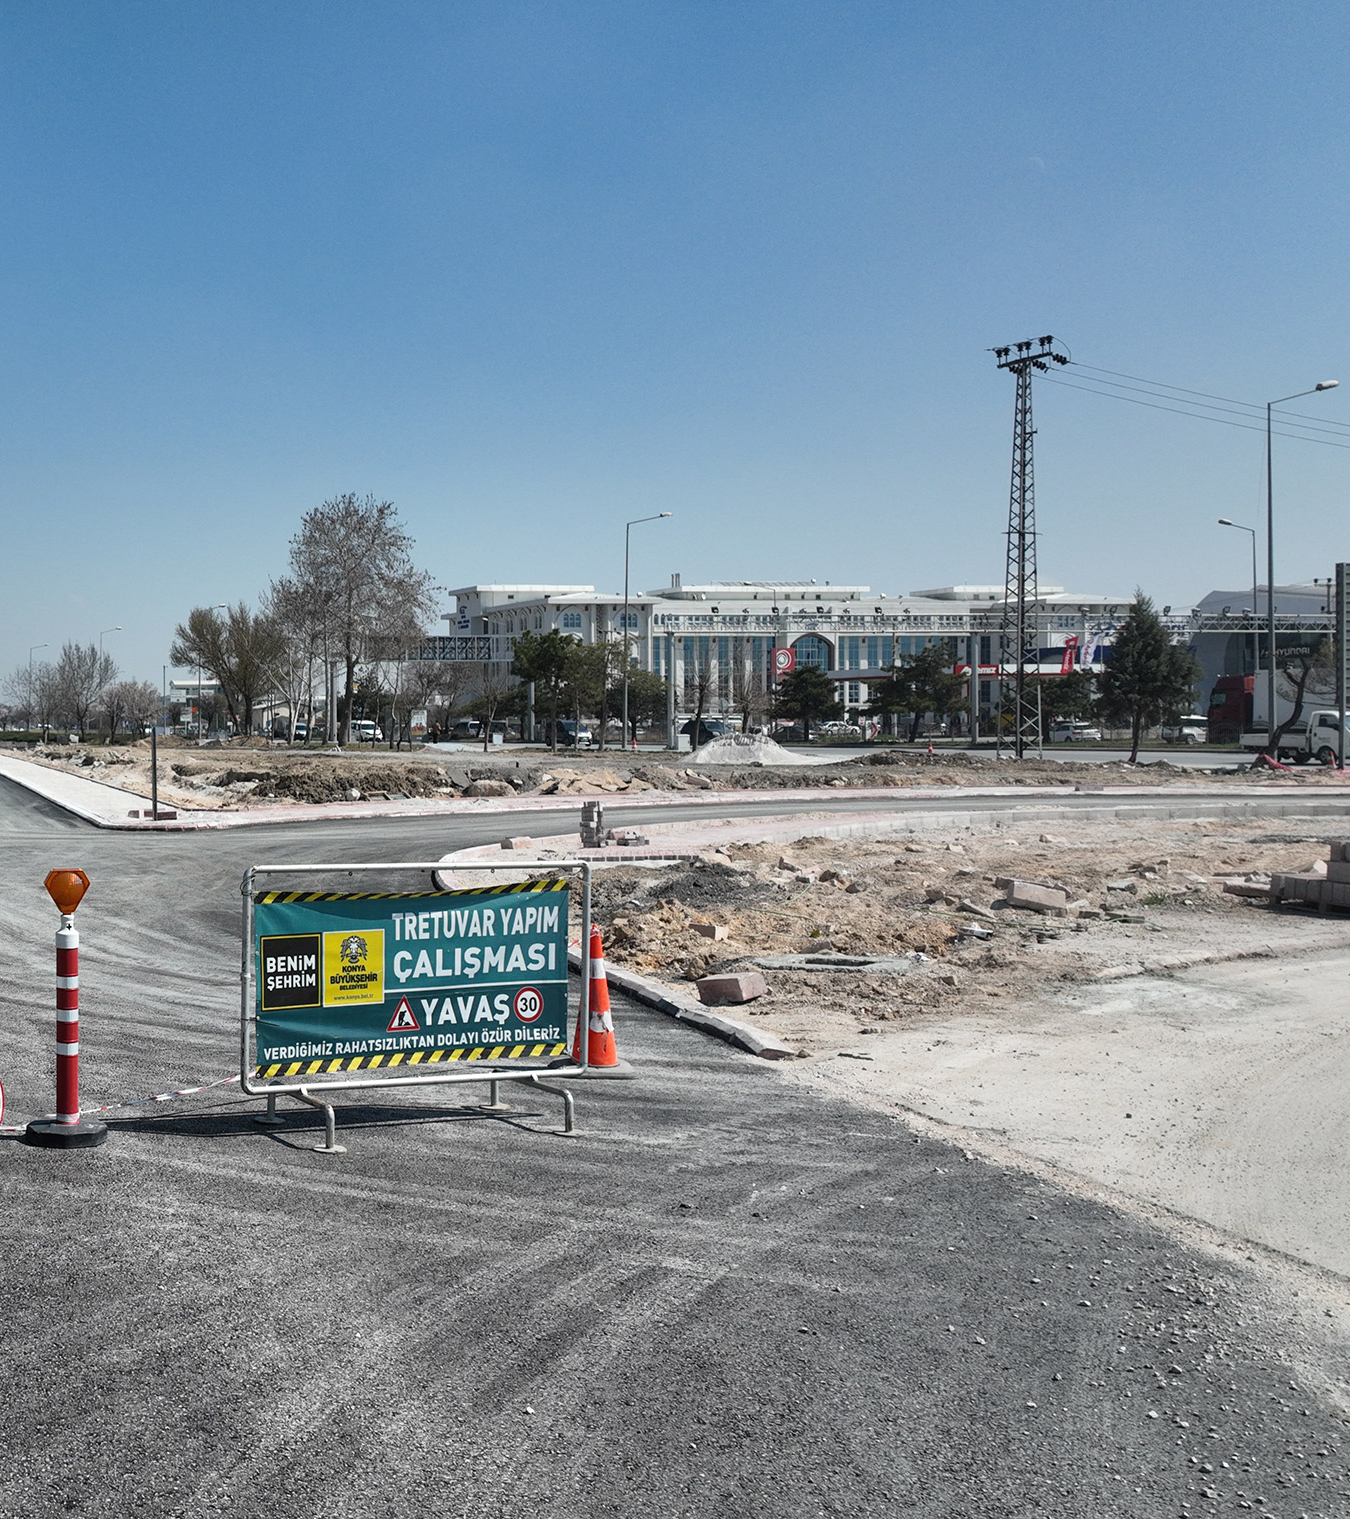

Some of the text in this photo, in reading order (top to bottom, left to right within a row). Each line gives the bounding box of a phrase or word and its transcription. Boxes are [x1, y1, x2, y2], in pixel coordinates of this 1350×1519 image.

[391, 905, 559, 941] TRETUVAR YAPIM
[342, 965, 366, 973] KONYA
[393, 942, 556, 983] ÇALIŞMASI
[267, 970, 316, 992] ŞEHRİM
[330, 973, 378, 985] BÜYÜKŞEHİR
[339, 983, 368, 991] BELEDİYESİ
[333, 992, 374, 1001] www.konya.bel.tr
[420, 994, 537, 1026] YAVAŞ 30
[263, 1024, 560, 1061] VERDİĞİMİZ RAHATSIZLIKTAN DOLAYI ÖZÜR DİLERİZ
